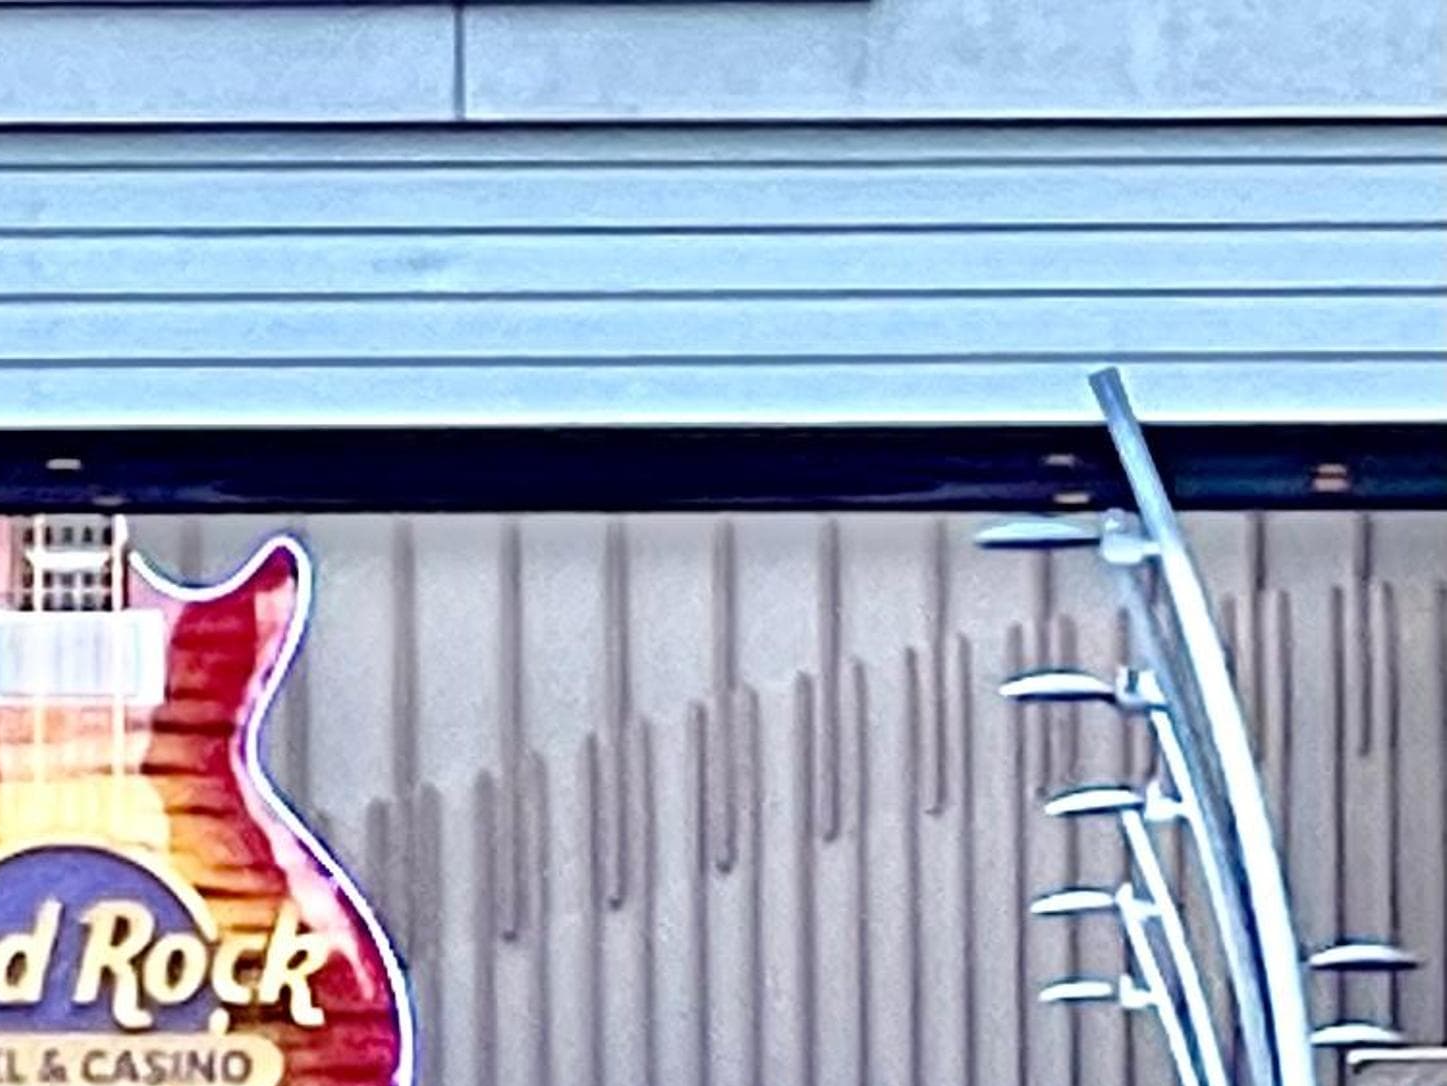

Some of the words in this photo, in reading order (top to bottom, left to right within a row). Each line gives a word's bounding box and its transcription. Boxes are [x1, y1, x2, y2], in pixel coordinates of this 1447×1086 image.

[74, 899, 331, 1029] Rock
[37, 1048, 69, 1085] &
[80, 1047, 254, 1084] CASINO
